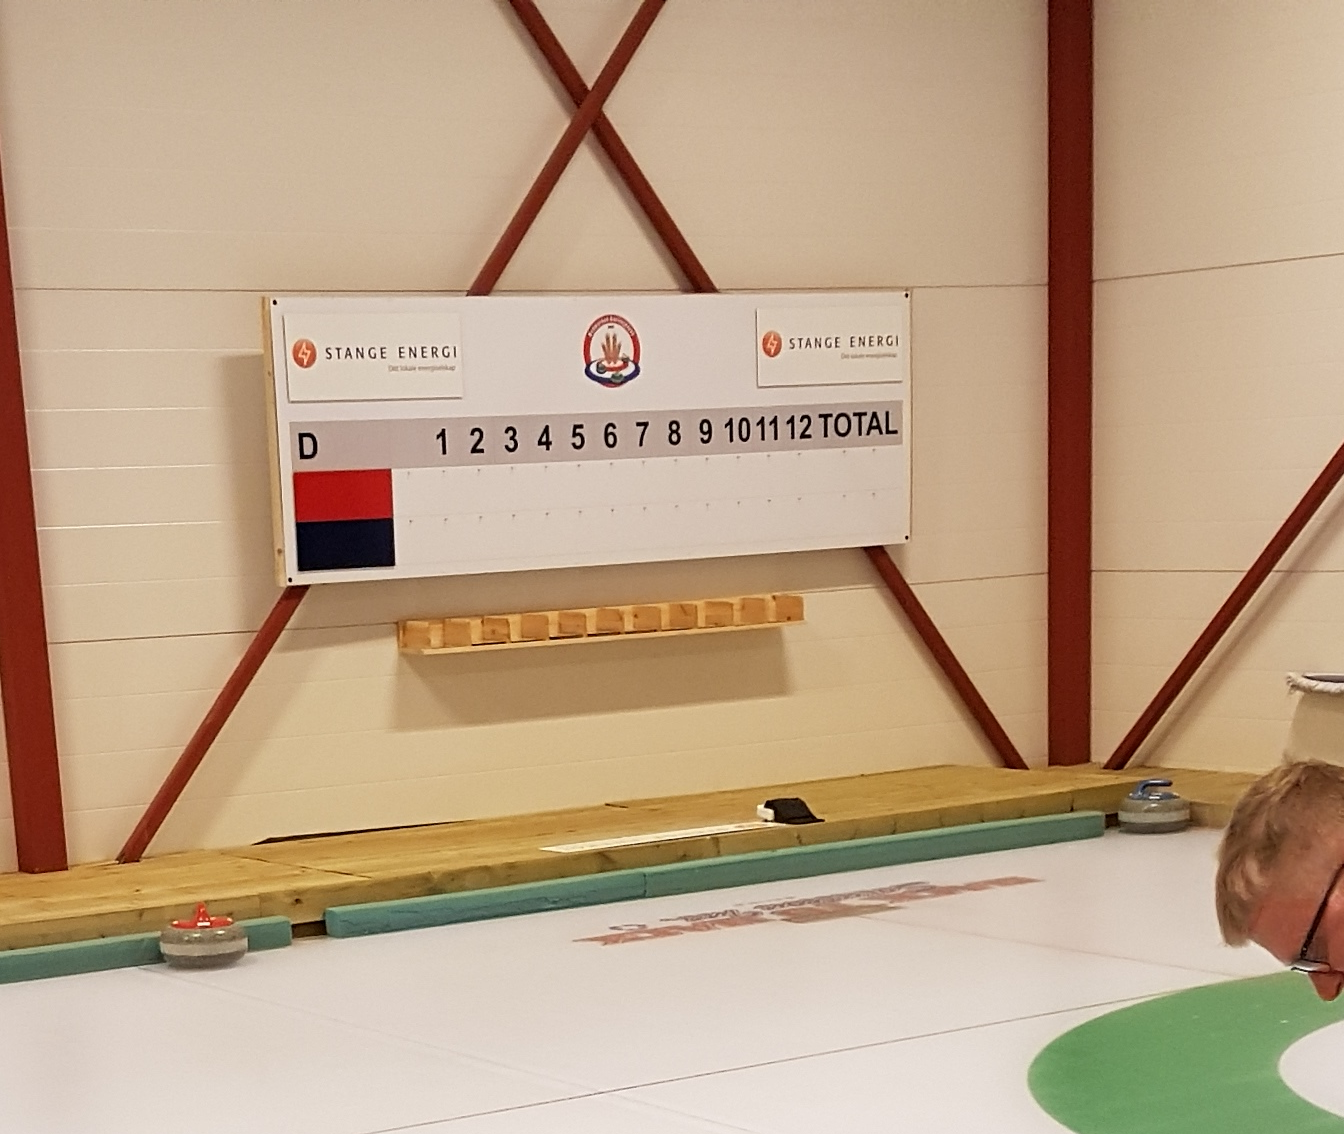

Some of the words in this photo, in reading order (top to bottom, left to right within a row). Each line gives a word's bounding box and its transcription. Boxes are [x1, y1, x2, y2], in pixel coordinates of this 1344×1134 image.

[789, 336, 840, 350] STANGE
[850, 335, 899, 348] ENERGI
[325, 346, 386, 360] STANGE
[398, 345, 457, 359] ENERGI
[297, 432, 318, 460] D
[436, 428, 447, 456] 1
[469, 427, 485, 454] 2
[504, 425, 519, 453] 3
[537, 424, 553, 451] 4
[571, 423, 586, 450] 5
[603, 422, 618, 449] 6
[635, 421, 650, 447] 7
[668, 419, 682, 446] 8
[699, 418, 713, 445] 9
[724, 417, 751, 443] 10
[756, 415, 779, 442] 11
[786, 414, 813, 440] 12
[818, 410, 899, 438] TOTAL
